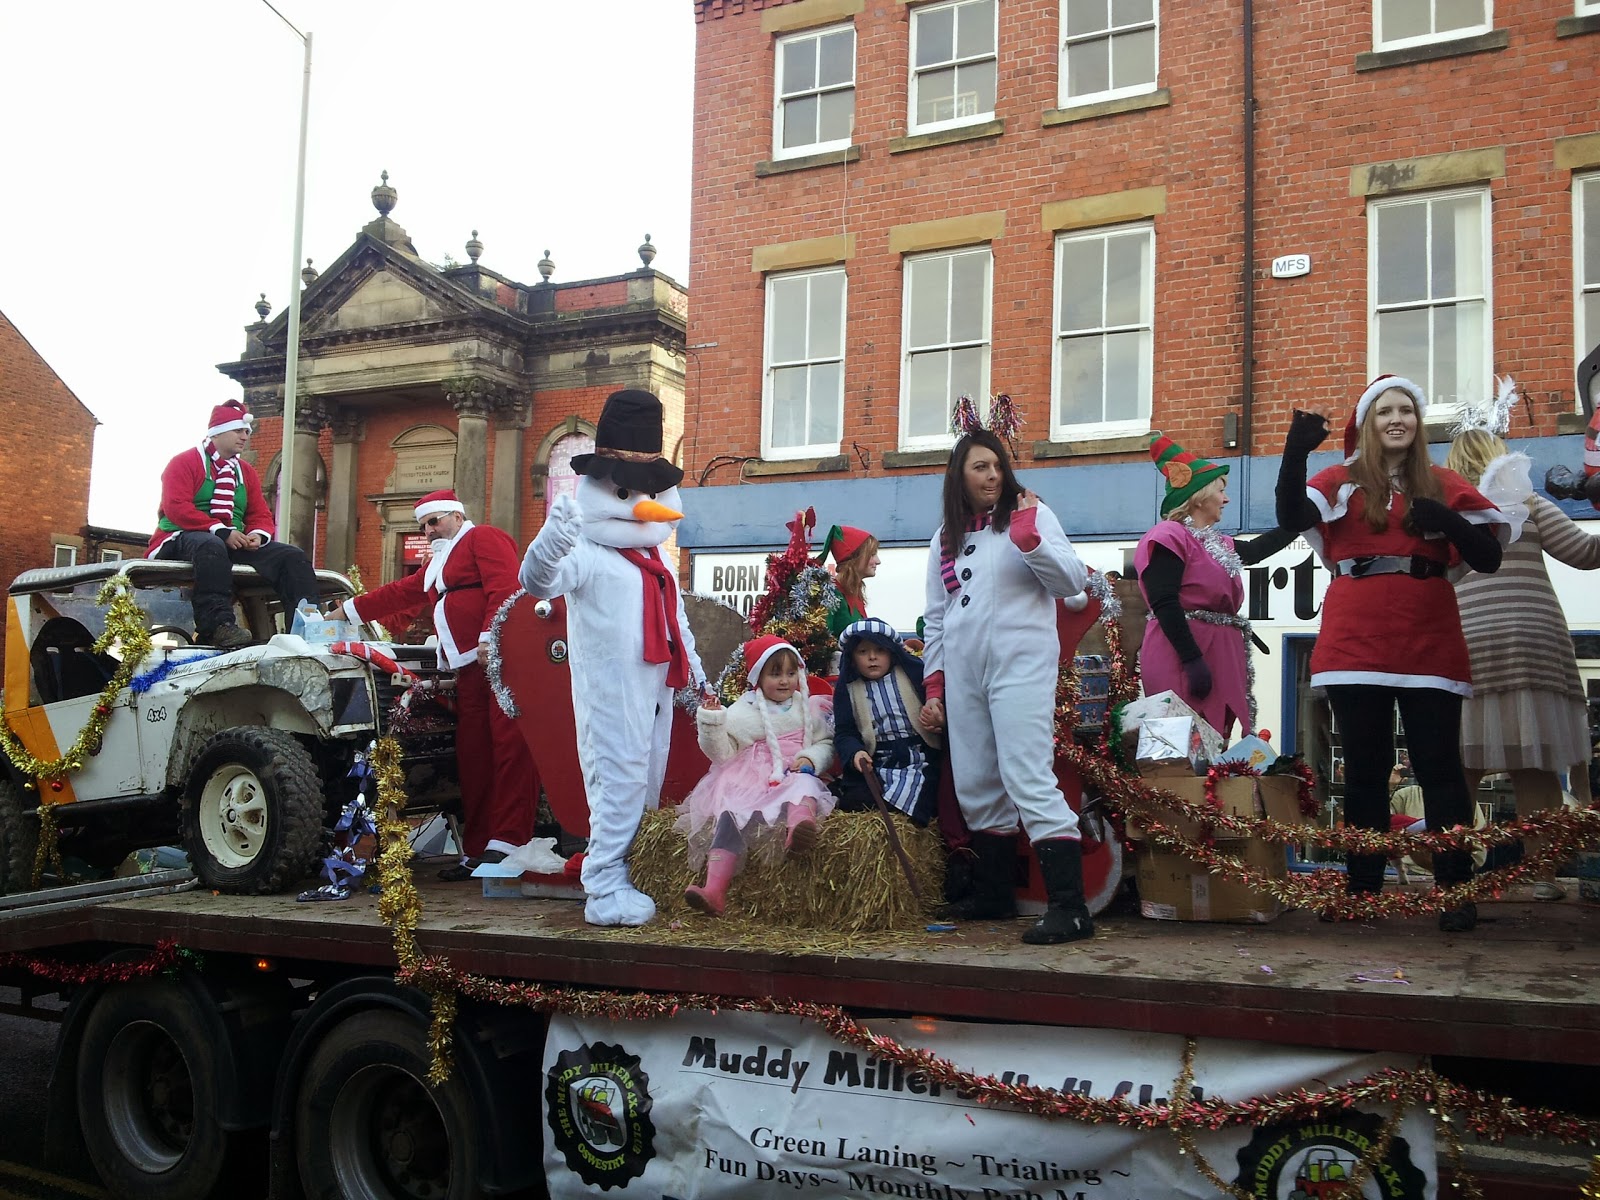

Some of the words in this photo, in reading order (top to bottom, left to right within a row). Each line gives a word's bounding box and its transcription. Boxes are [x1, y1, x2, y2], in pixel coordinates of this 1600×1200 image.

[1276, 259, 1305, 272] MFS
[713, 565, 760, 592] BORN
[147, 706, 168, 723] 4x4
[681, 1036, 810, 1094] Muddy
[558, 1108, 574, 1138] THE
[589, 1062, 635, 1090] MILLERS
[632, 1122, 643, 1155] CLUB
[577, 1142, 626, 1171] OSWESTRY
[704, 1148, 748, 1177] Fun
[750, 1126, 827, 1157] Green
[836, 1137, 938, 1176] Laning
[972, 1153, 1103, 1186] Trialing
[1255, 1134, 1293, 1200] MUDDY
